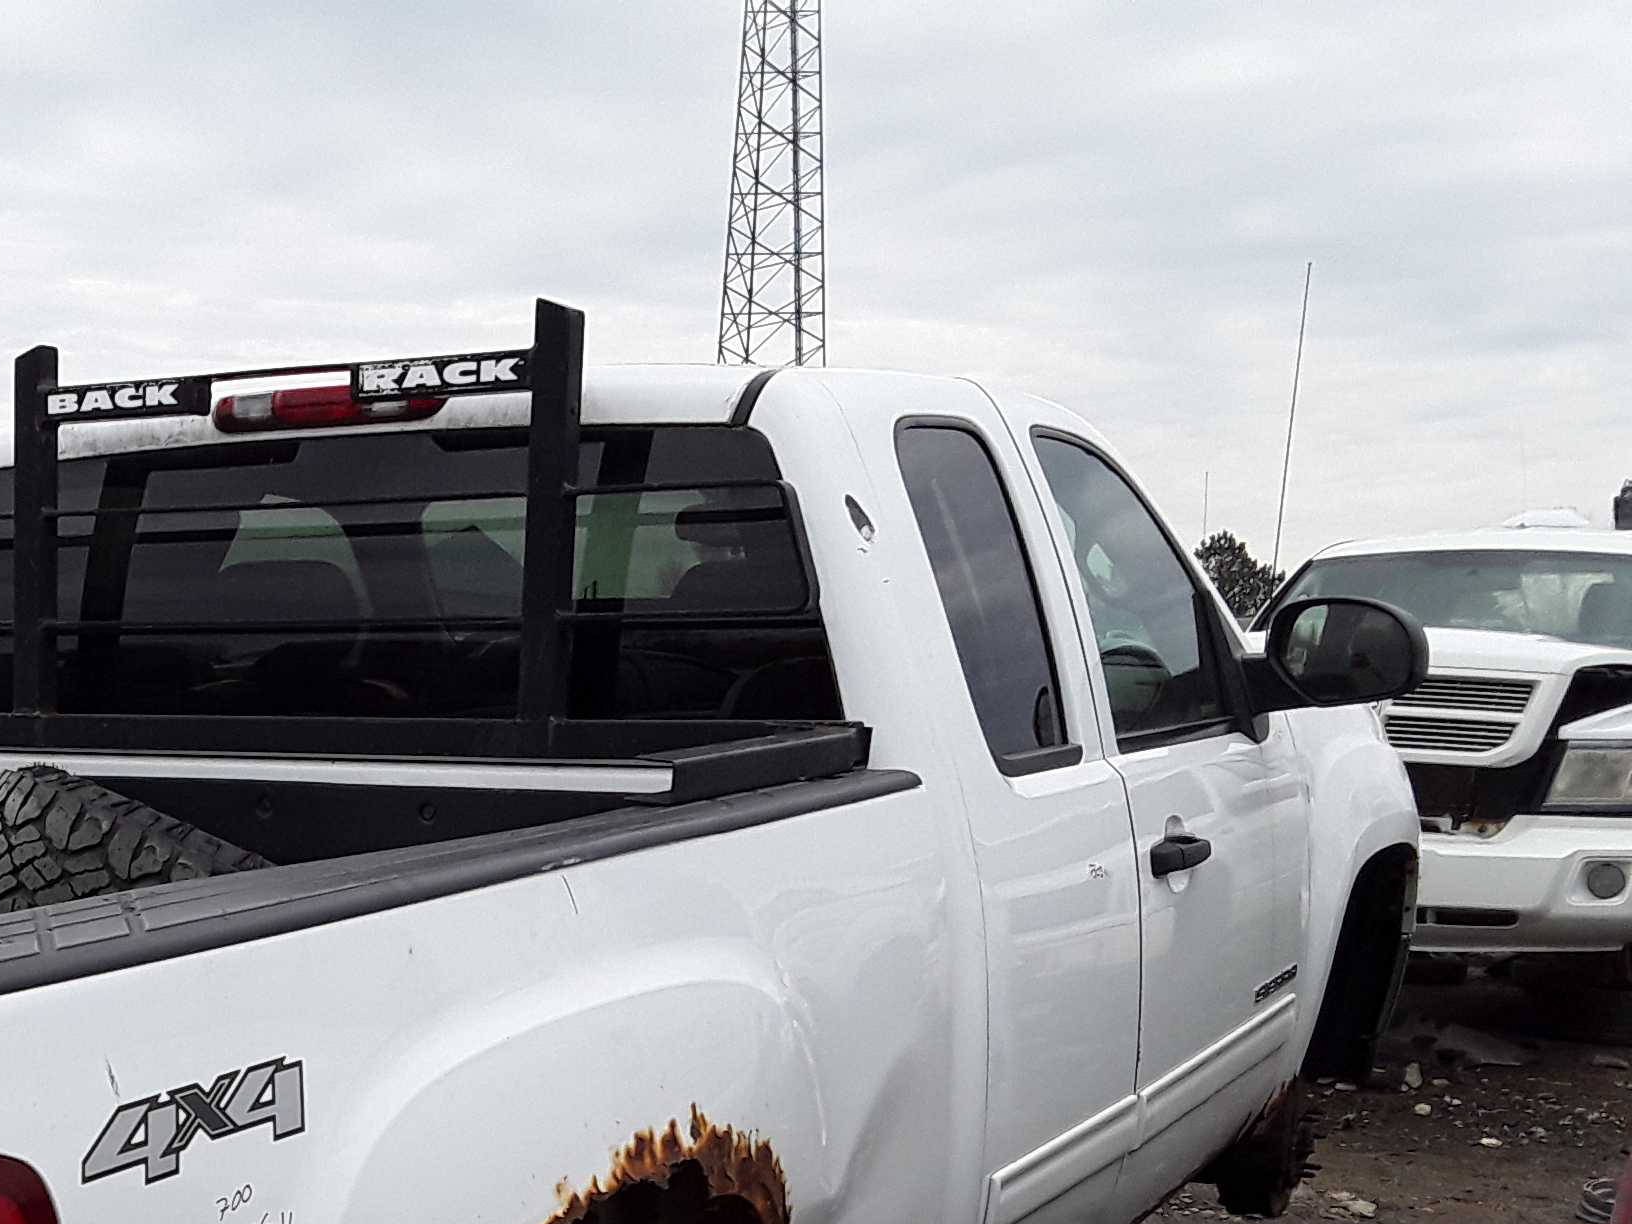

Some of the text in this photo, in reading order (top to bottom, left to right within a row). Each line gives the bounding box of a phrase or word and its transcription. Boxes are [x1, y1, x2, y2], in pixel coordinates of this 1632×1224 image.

[47, 358, 522, 415] BACK RACK
[80, 1055, 306, 1186] 4X4
[216, 1183, 253, 1222] 700
